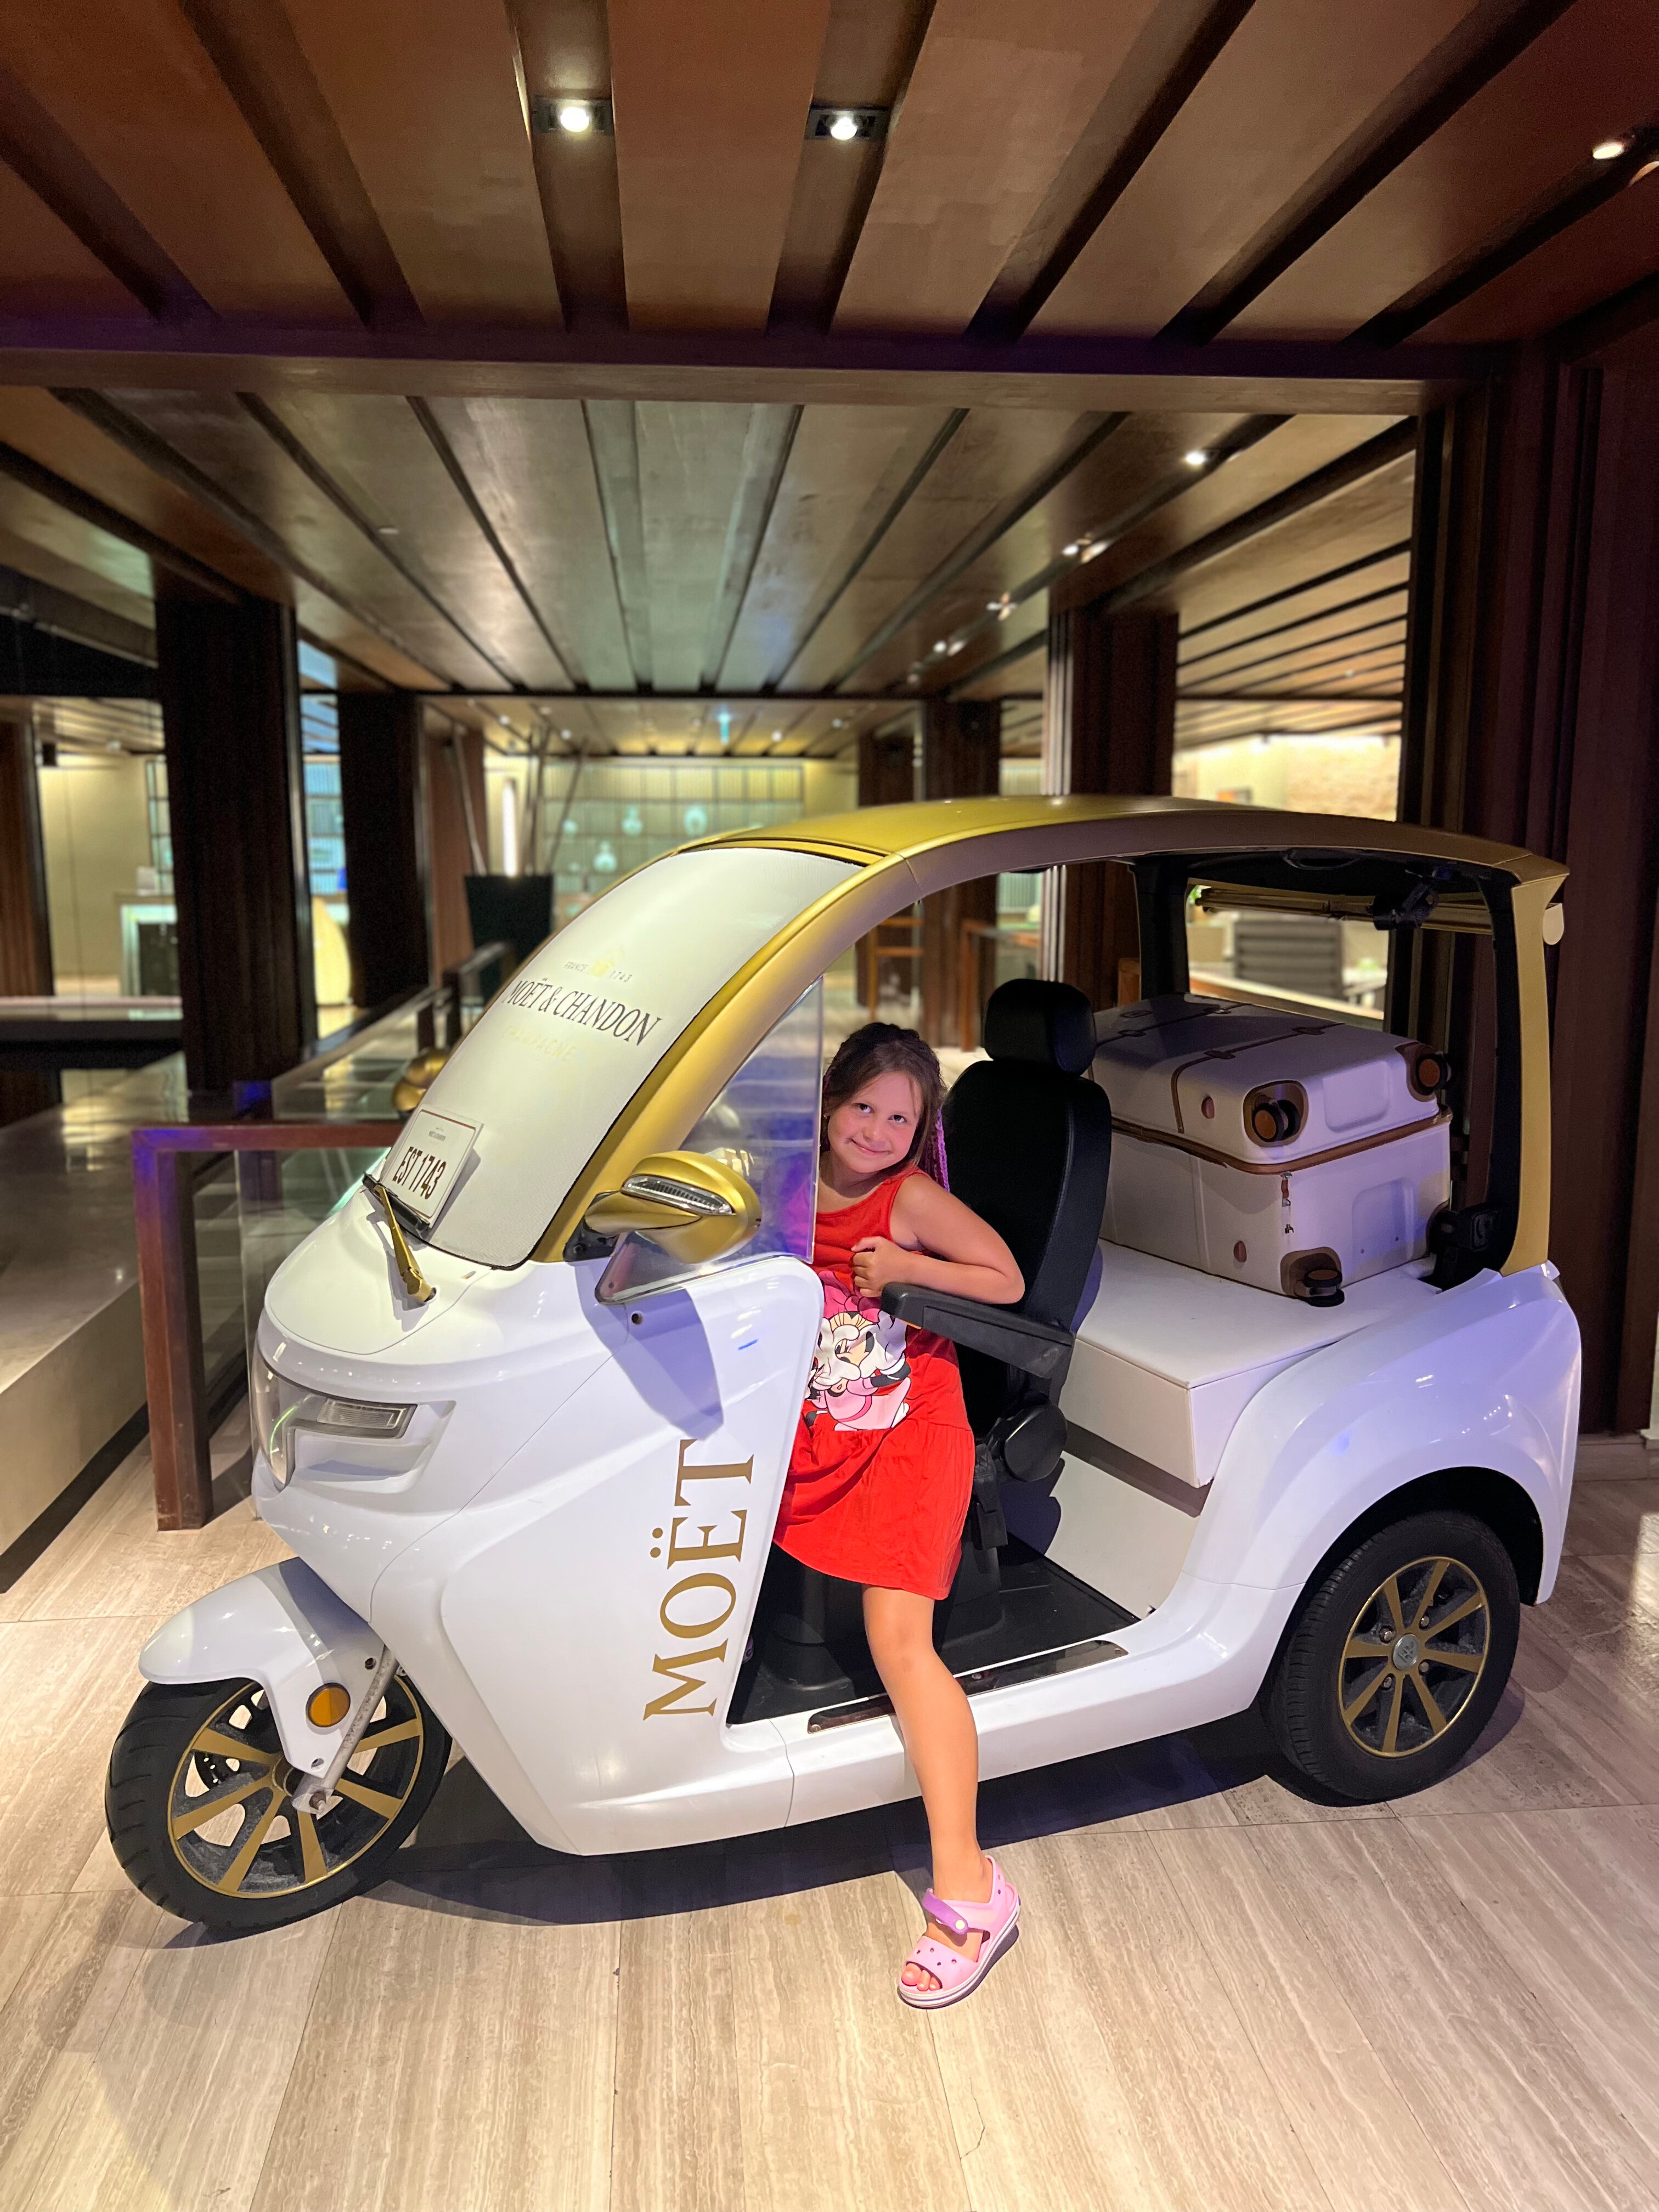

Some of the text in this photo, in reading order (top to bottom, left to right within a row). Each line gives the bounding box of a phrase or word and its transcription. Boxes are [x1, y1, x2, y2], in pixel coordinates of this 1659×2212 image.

[609, 970, 634, 983] 1743
[501, 978, 663, 1046] MOËT & CHANDON
[392, 1146, 447, 1200] EST 1743
[642, 1438, 754, 1721] MOËT
